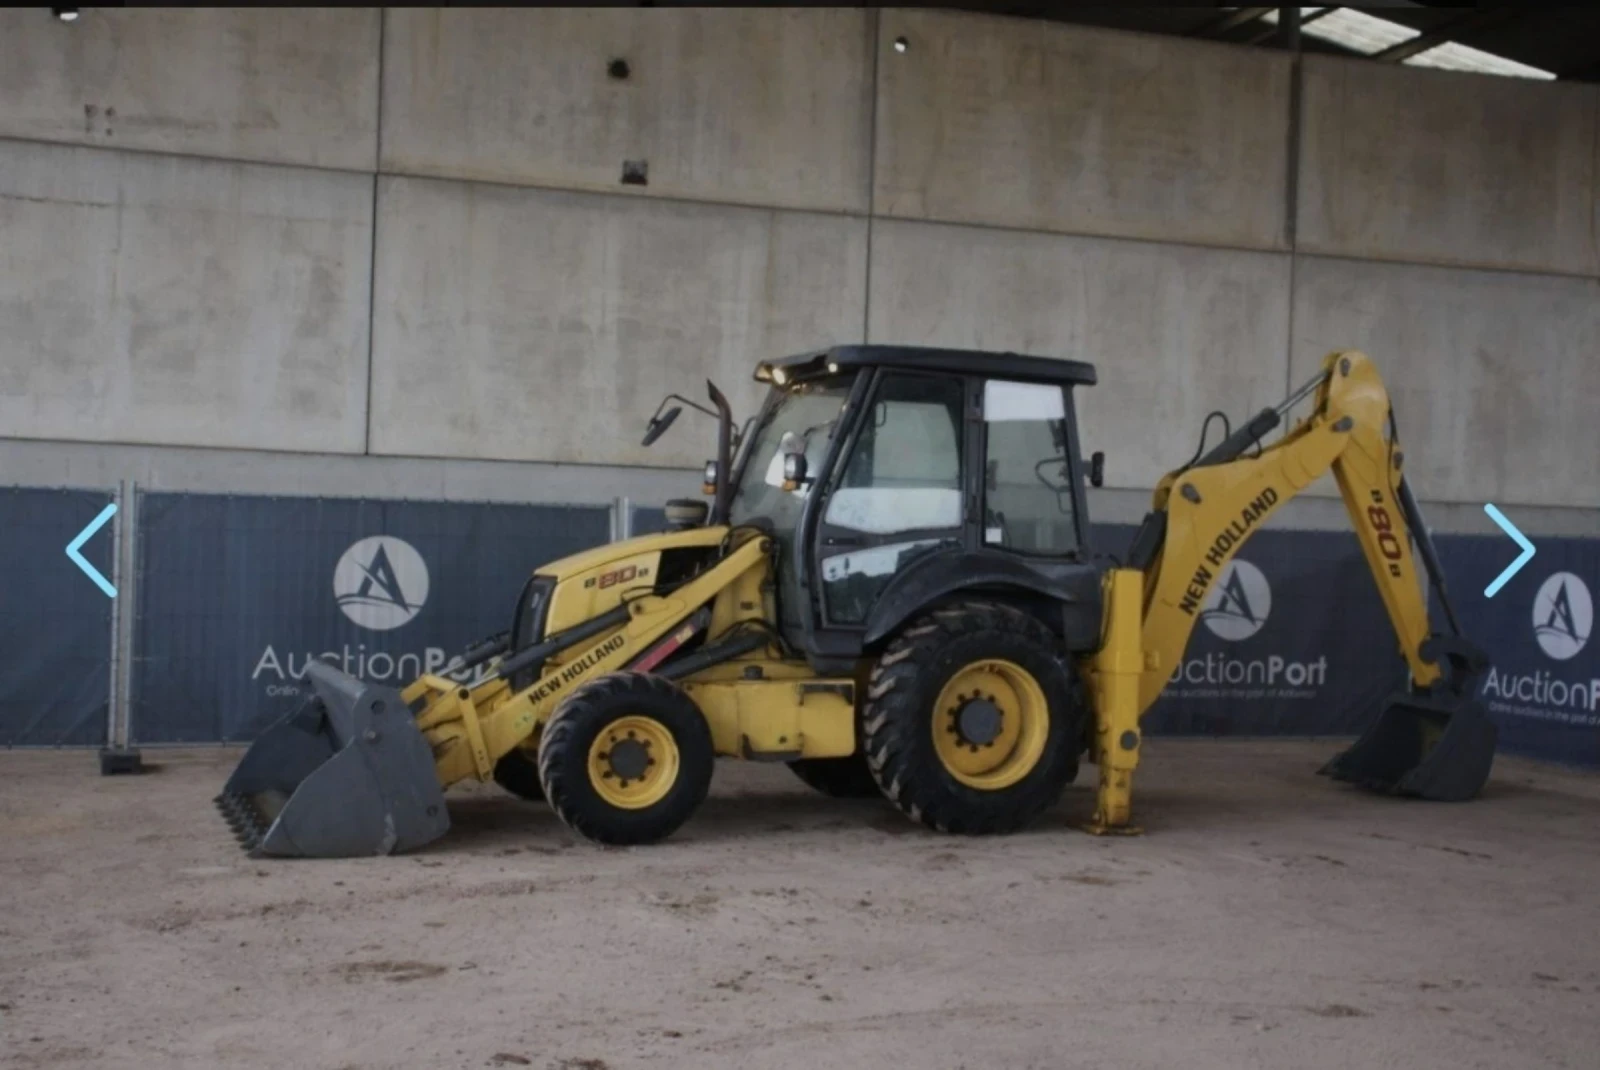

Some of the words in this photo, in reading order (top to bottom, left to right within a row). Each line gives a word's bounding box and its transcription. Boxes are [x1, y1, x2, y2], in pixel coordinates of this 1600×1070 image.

[1178, 564, 1213, 616] NEW
[1205, 487, 1278, 567] HOLLAND
[527, 676, 561, 705] NEW
[561, 635, 625, 683] HOLLAND
[1167, 653, 1327, 686] uctionPort
